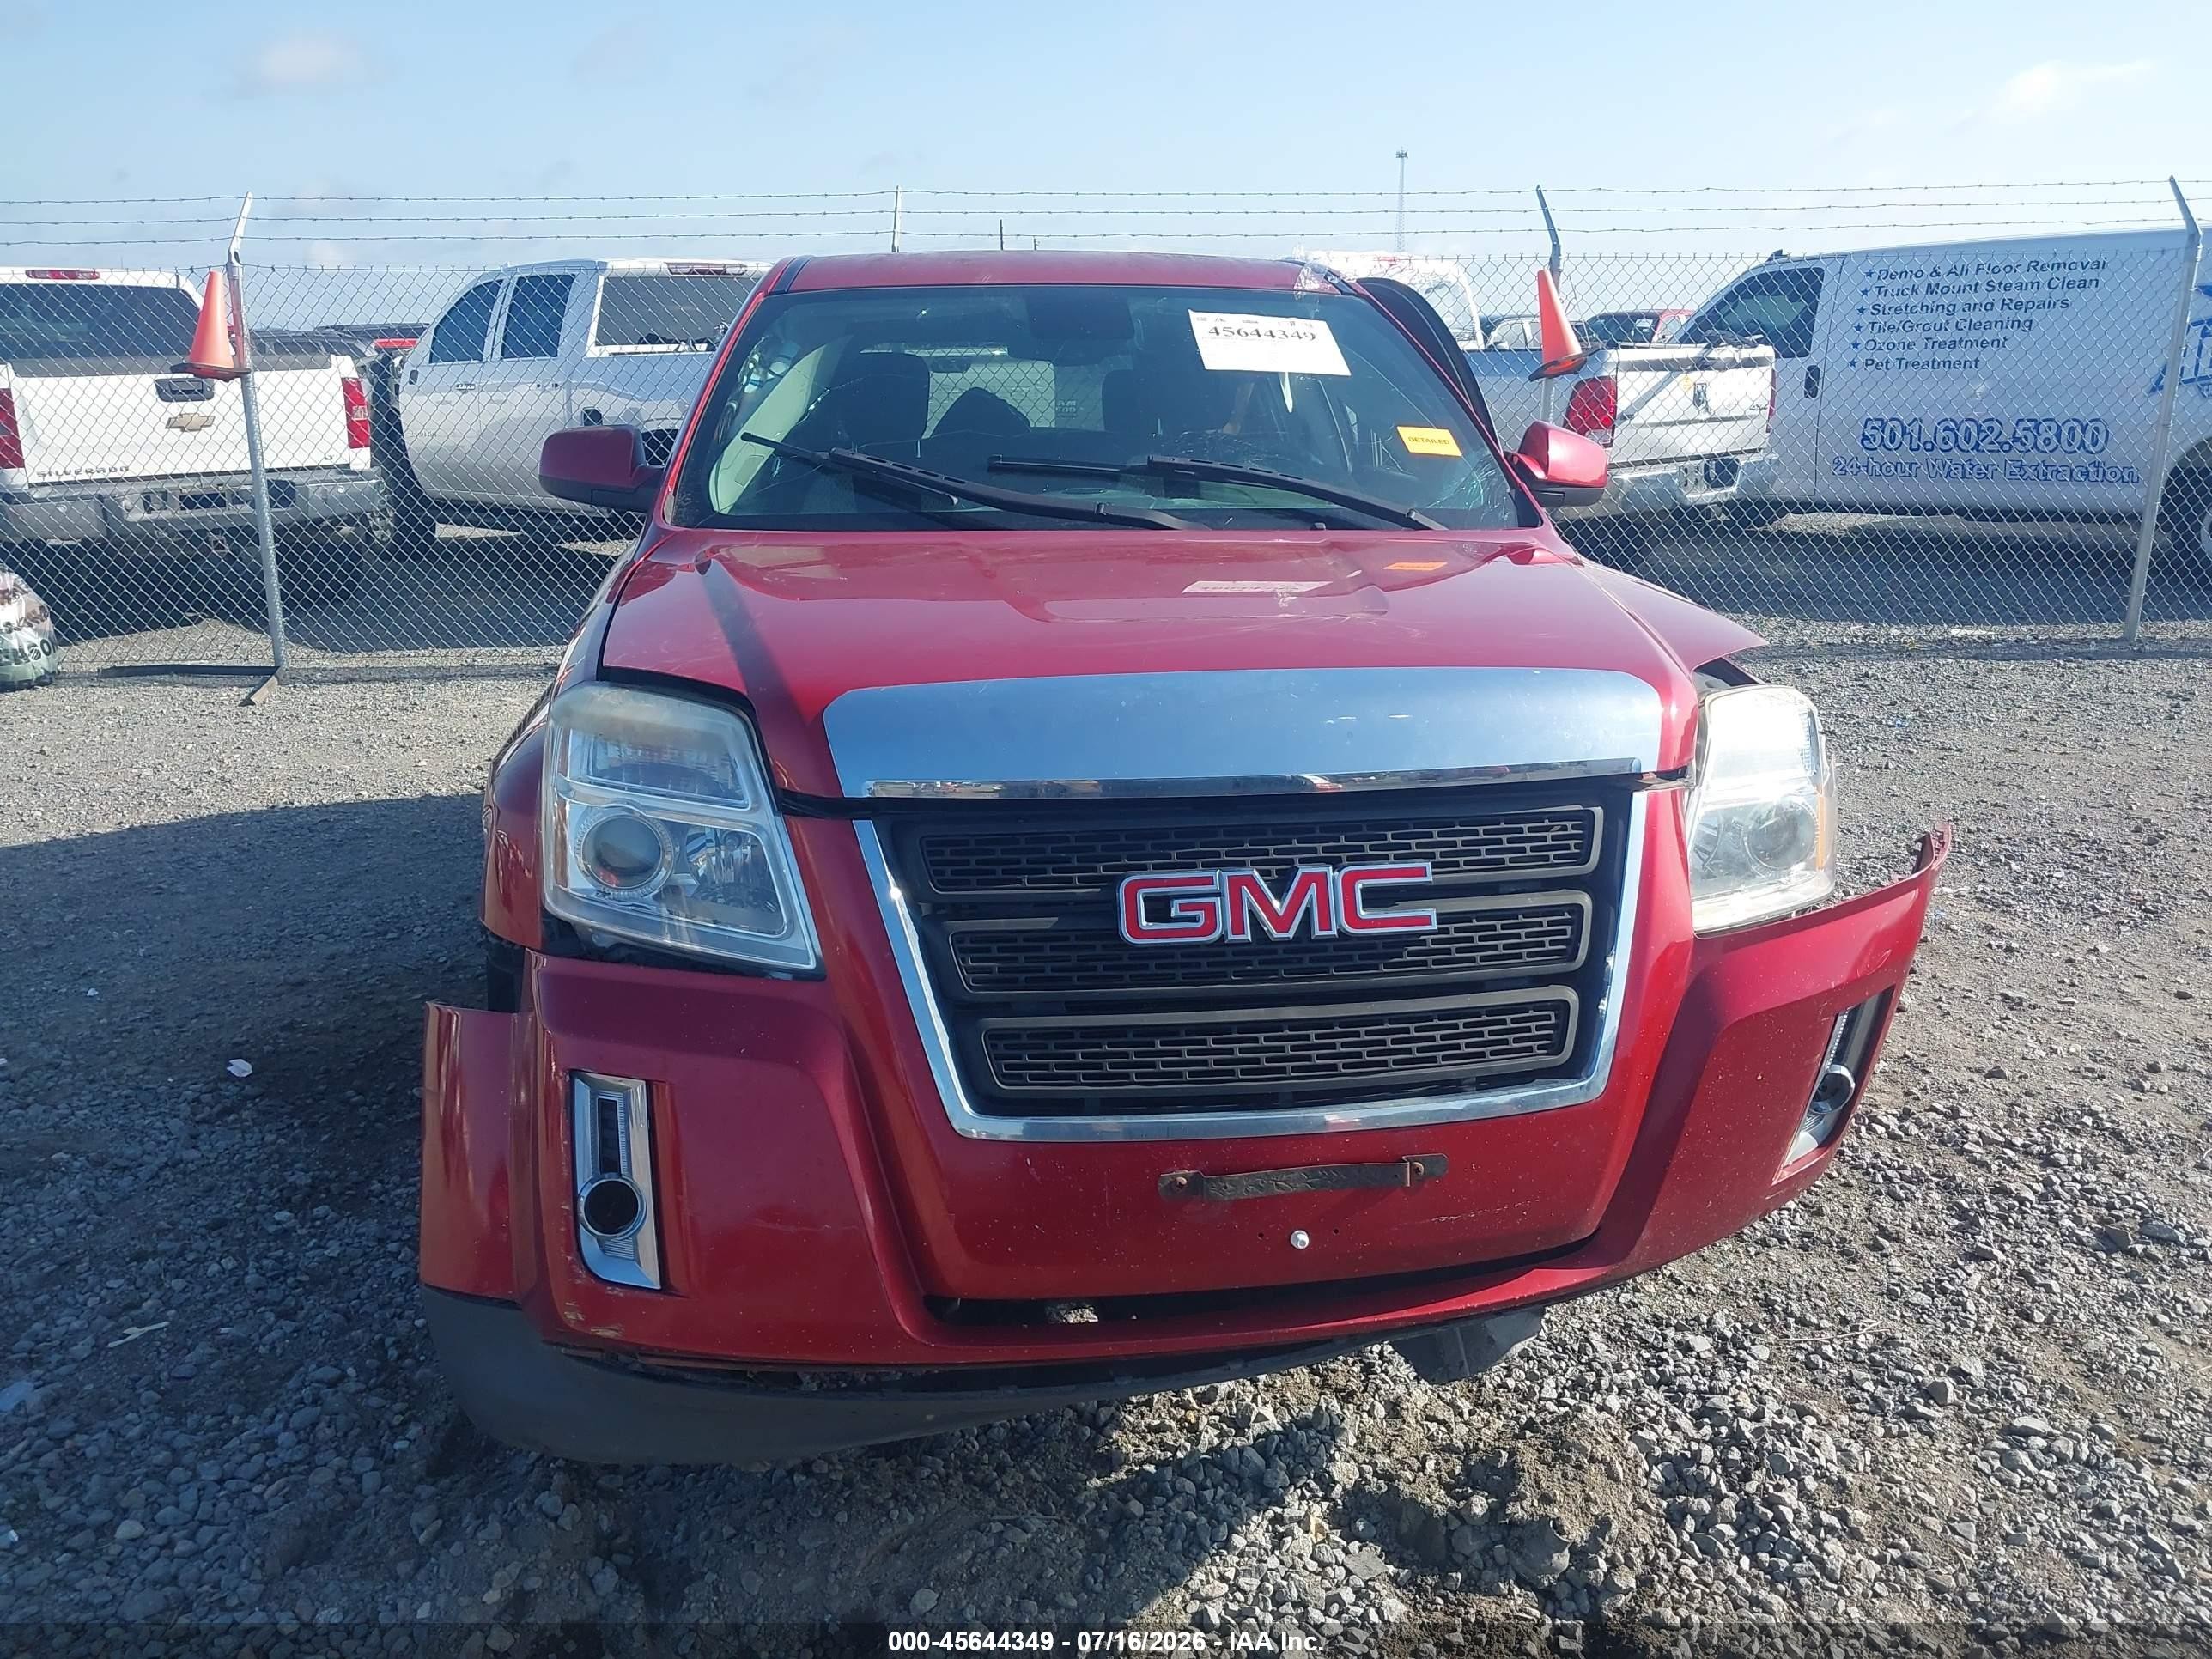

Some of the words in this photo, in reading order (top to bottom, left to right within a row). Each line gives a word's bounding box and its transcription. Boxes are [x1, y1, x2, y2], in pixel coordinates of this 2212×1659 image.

[1877, 268, 1924, 281] Demo
[1929, 264, 1941, 278] &
[1975, 262, 2022, 275] Floor
[2026, 257, 2107, 273] Removal
[1875, 283, 1920, 297] Truck
[1925, 281, 1979, 296] Mount
[1984, 279, 2040, 293] Steam
[2047, 276, 2100, 290] Clean
[1870, 301, 1957, 316] Stretching
[1962, 298, 1995, 313] and
[2000, 297, 2070, 313] Repairs
[1208, 325, 1316, 341] 45644349
[1868, 320, 1952, 334] Tile/Grout
[1955, 319, 2033, 332] Cleaning
[1863, 338, 1917, 351] Ozone
[1923, 335, 2008, 351] Treatment
[1863, 357, 1890, 371] Pet
[1895, 356, 1980, 371] Treatment
[1408, 435, 1450, 445] DETAILED
[1860, 416, 2110, 454] 501.602.5800
[1832, 456, 1927, 479] 24-hour
[1926, 458, 1998, 481] Water
[2003, 459, 2141, 484] Extraction
[1118, 861, 1438, 945] GMC
